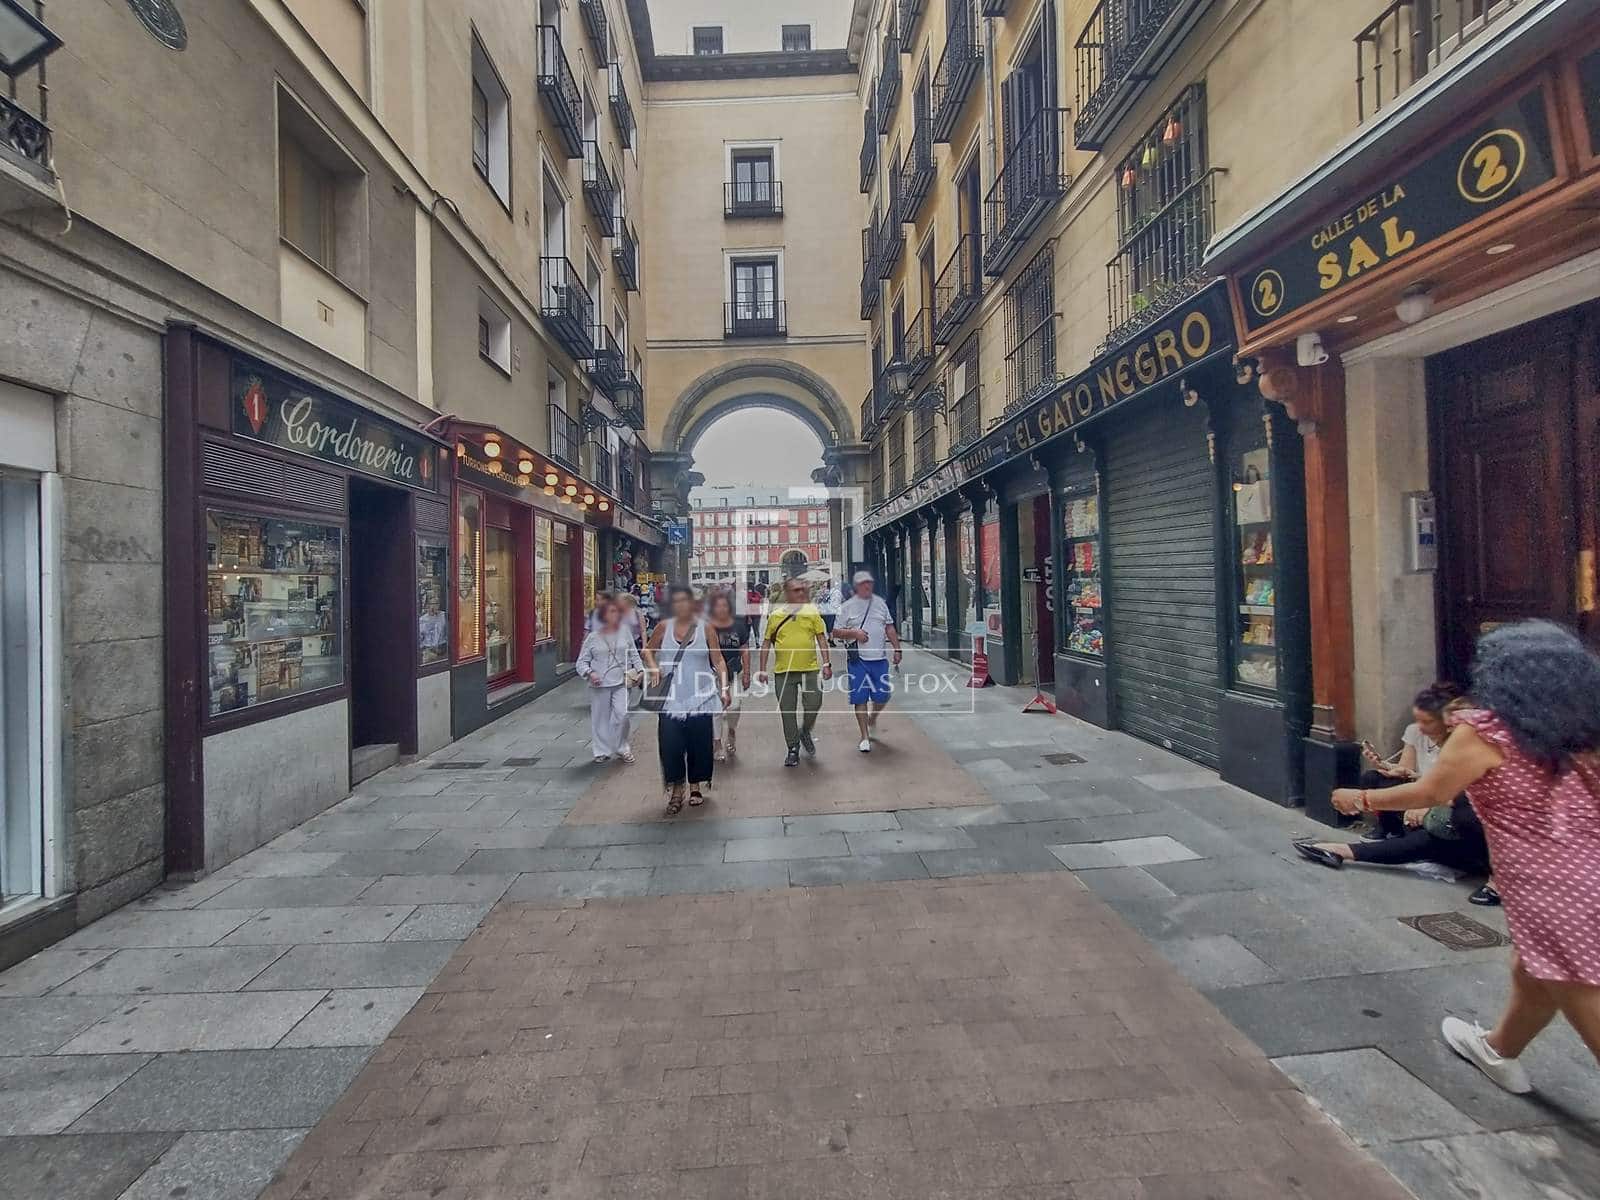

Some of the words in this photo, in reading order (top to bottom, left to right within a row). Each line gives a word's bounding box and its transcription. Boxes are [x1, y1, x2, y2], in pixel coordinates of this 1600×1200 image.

[1474, 145, 1507, 193] 2
[1311, 213, 1354, 250] CALLE
[1358, 204, 1377, 224] DE
[1382, 184, 1406, 209] LA
[1316, 216, 1416, 290] SAL
[1258, 278, 1276, 309] 2
[251, 393, 260, 421] 1
[1015, 417, 1036, 450] EL
[1038, 382, 1093, 438] GATO
[1097, 311, 1211, 408] NEGRO
[281, 396, 414, 480] Cordoneria
